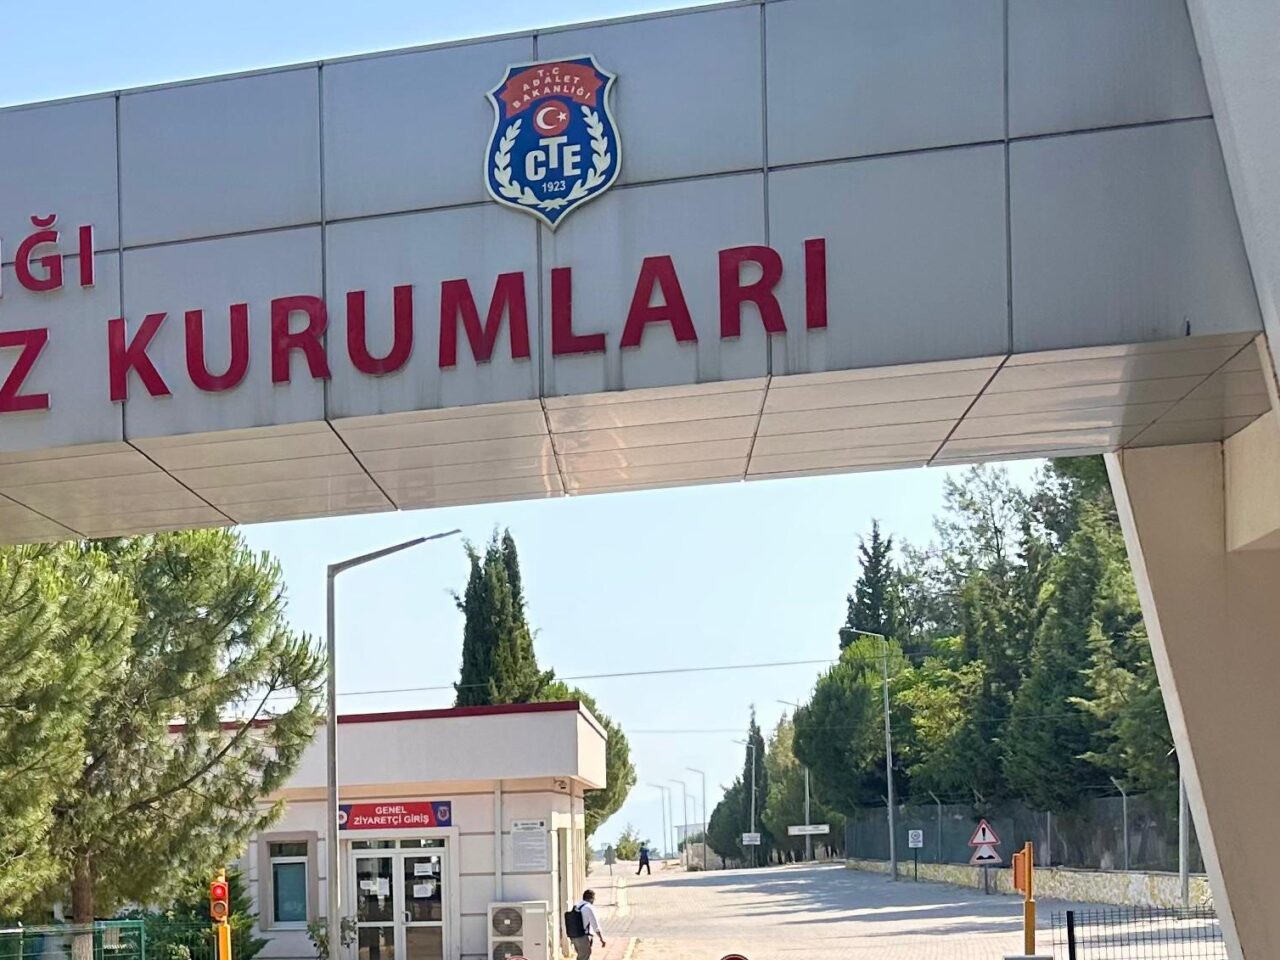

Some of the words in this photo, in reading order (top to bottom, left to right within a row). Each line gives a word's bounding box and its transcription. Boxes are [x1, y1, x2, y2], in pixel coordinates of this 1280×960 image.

[537, 67, 560, 78] T.C
[522, 74, 581, 92] ADALET
[511, 84, 591, 109] BAKANLIĞI
[524, 135, 582, 181] CTE
[541, 180, 567, 193] 1923
[107, 238, 828, 401] KURUMLARI
[375, 806, 407, 815] GENEL
[353, 814, 402, 825] ZİYARETÇİ
[403, 813, 430, 824] GİRİŞ
